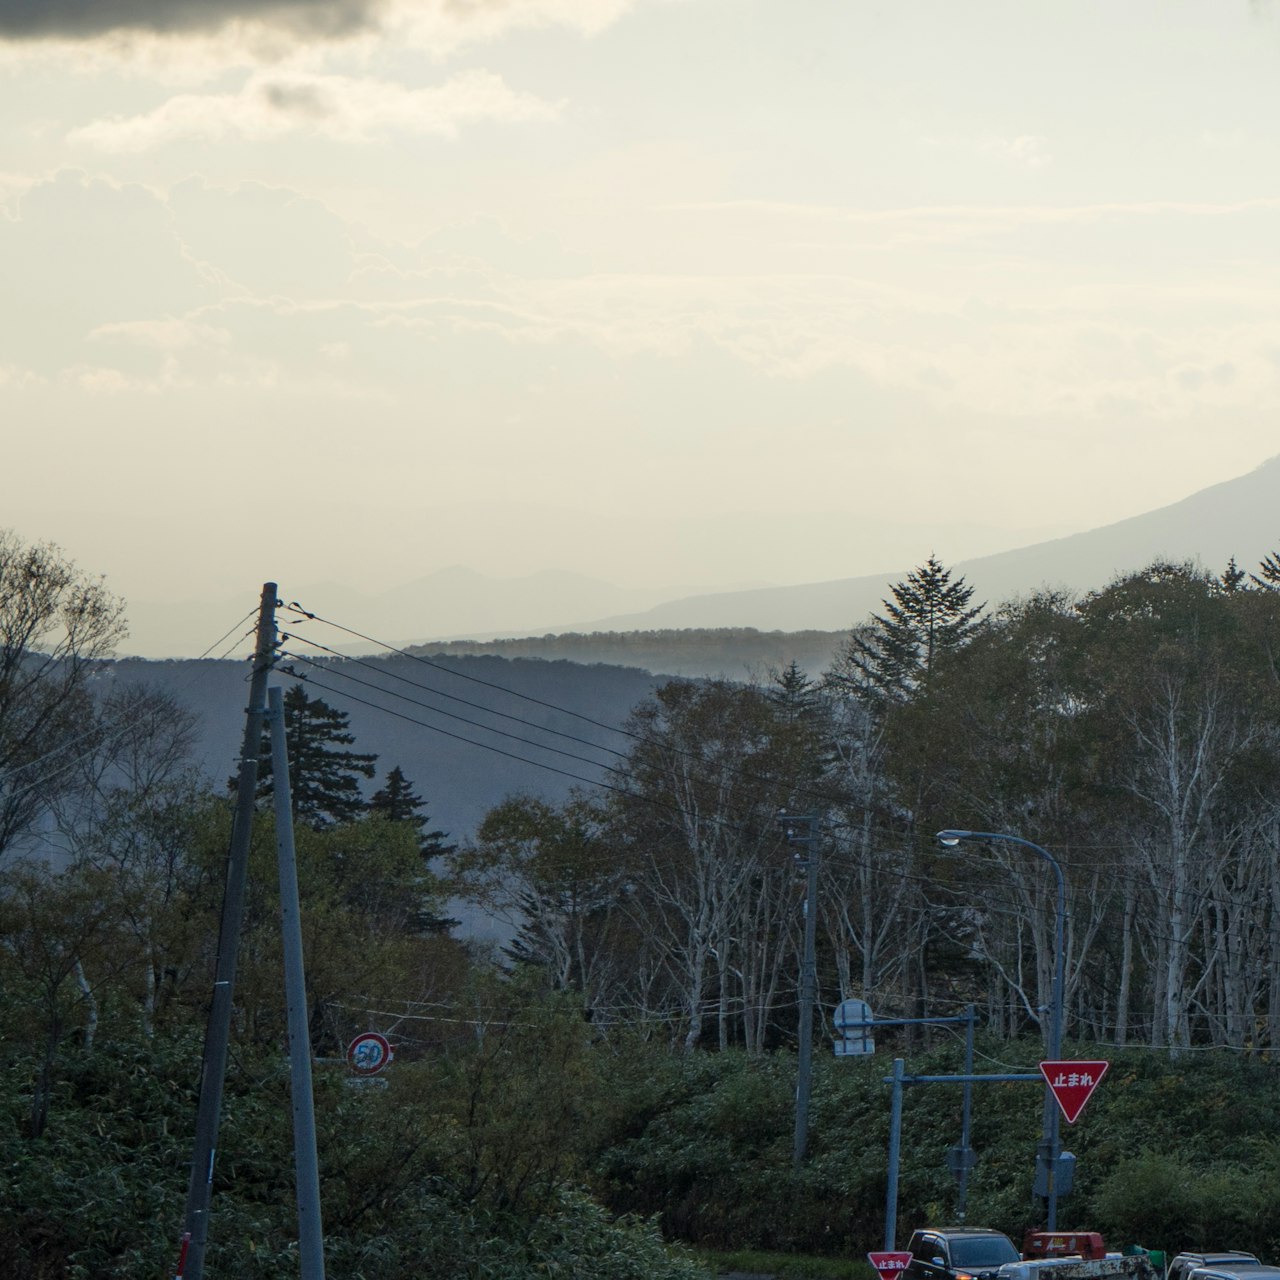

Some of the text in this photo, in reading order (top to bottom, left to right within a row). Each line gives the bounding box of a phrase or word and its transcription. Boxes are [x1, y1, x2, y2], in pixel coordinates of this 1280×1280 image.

[357, 1044, 381, 1064] 50
[1053, 1072, 1094, 1087] 止まれ
[878, 1260, 905, 1270] 止まれ
